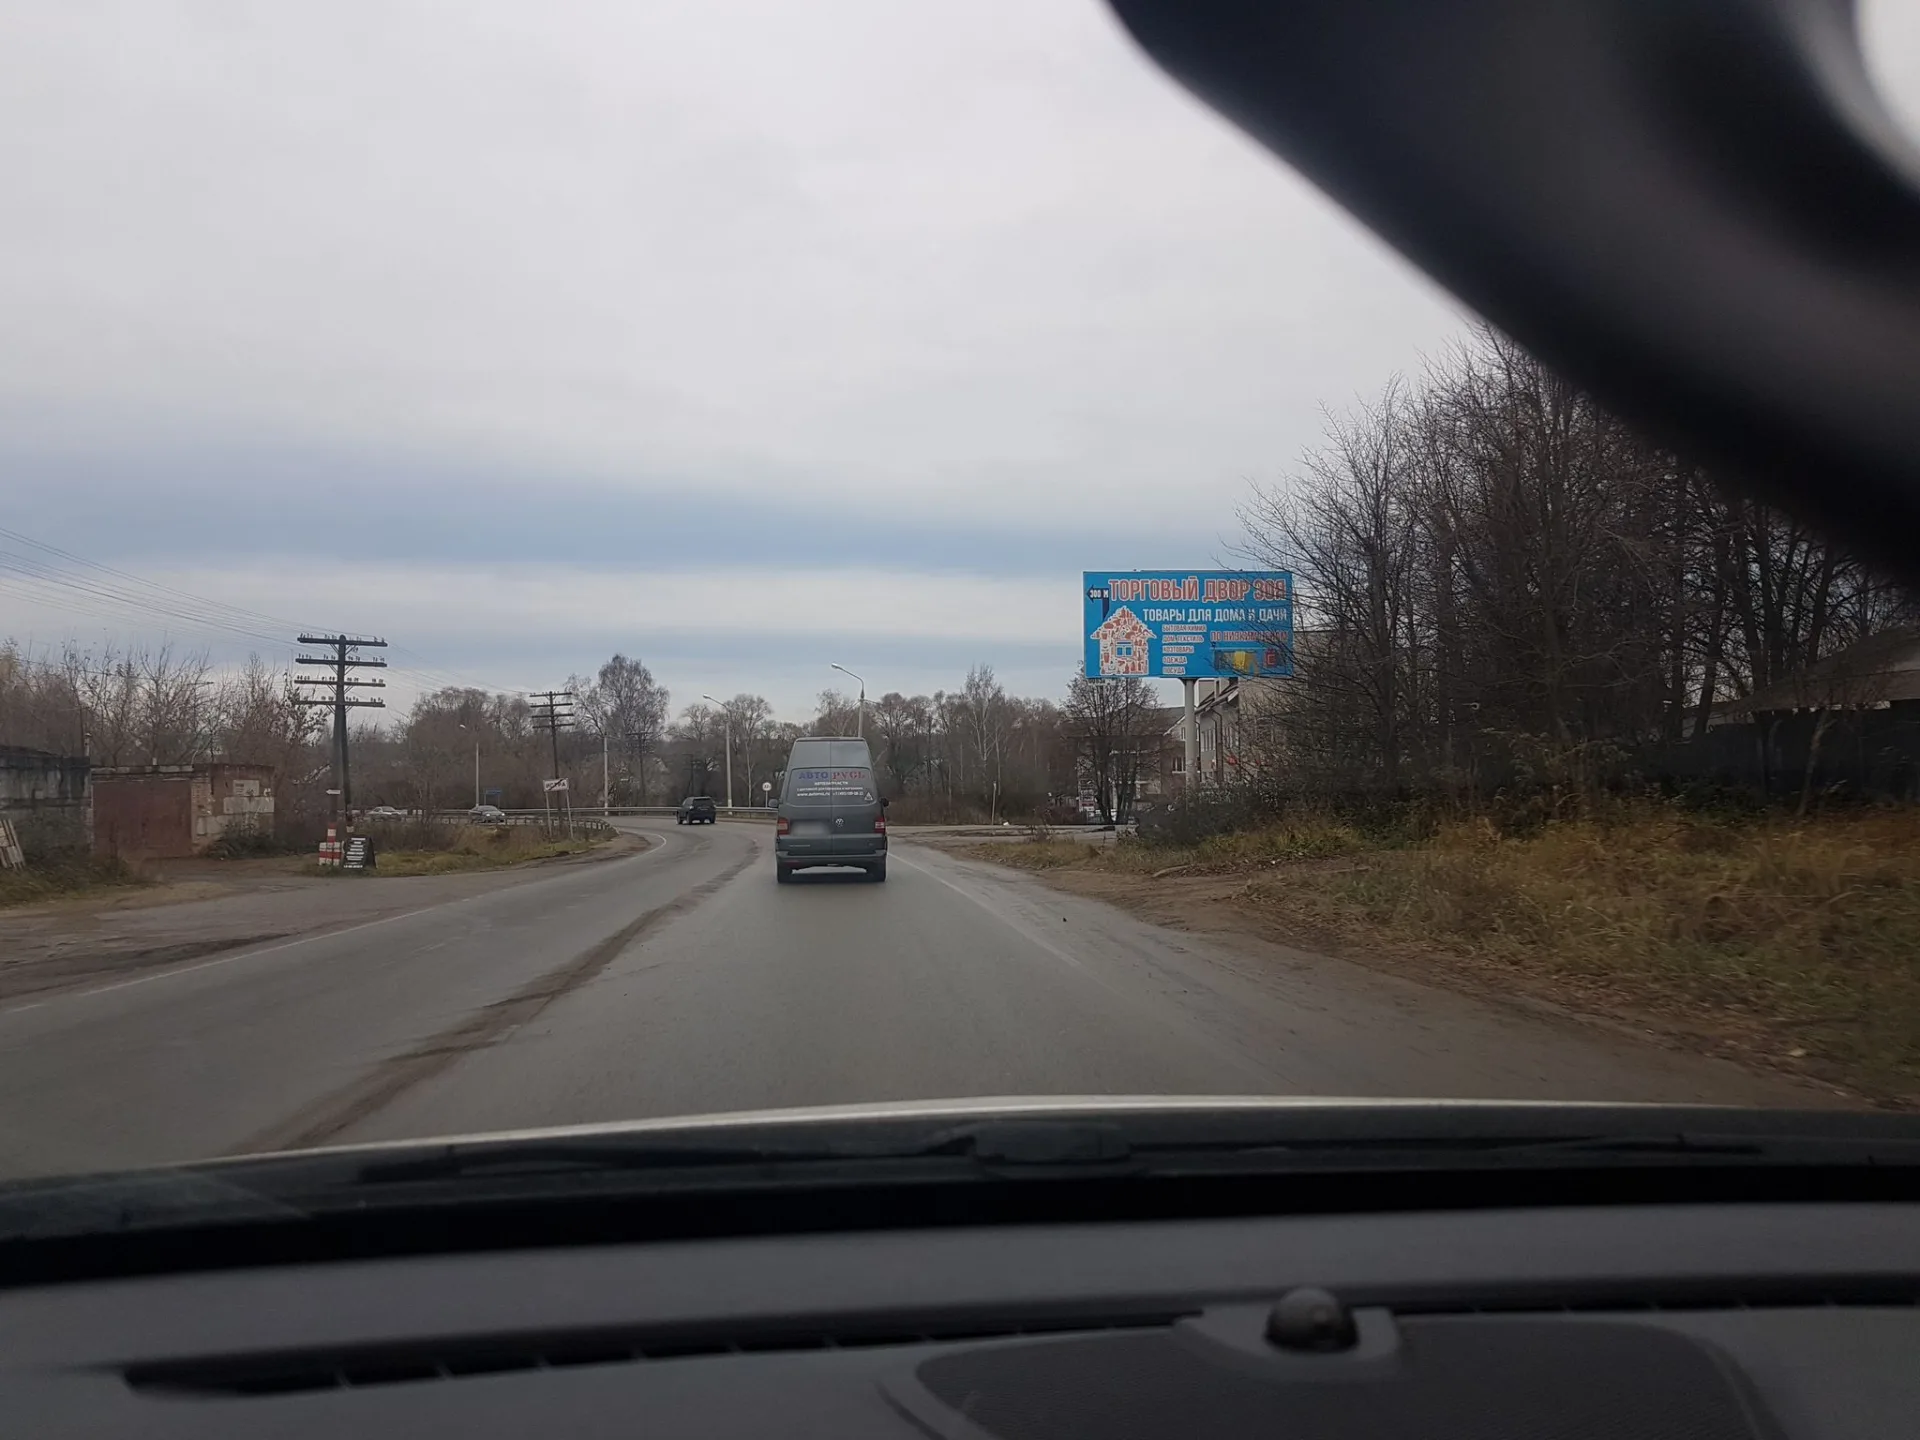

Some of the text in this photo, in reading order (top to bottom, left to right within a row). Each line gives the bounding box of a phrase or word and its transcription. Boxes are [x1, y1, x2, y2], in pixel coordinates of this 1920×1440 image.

[1090, 589, 1101, 598] 300
[1108, 576, 1286, 603] ТОРГОВЫЙ ДВОР ЗОЯ
[1143, 608, 1287, 622] ТОВАРЫ ДЛЯ ДОМА И ДАЧИ
[1211, 631, 1222, 641] ПО
[1224, 631, 1257, 641] НИЗКИМ
